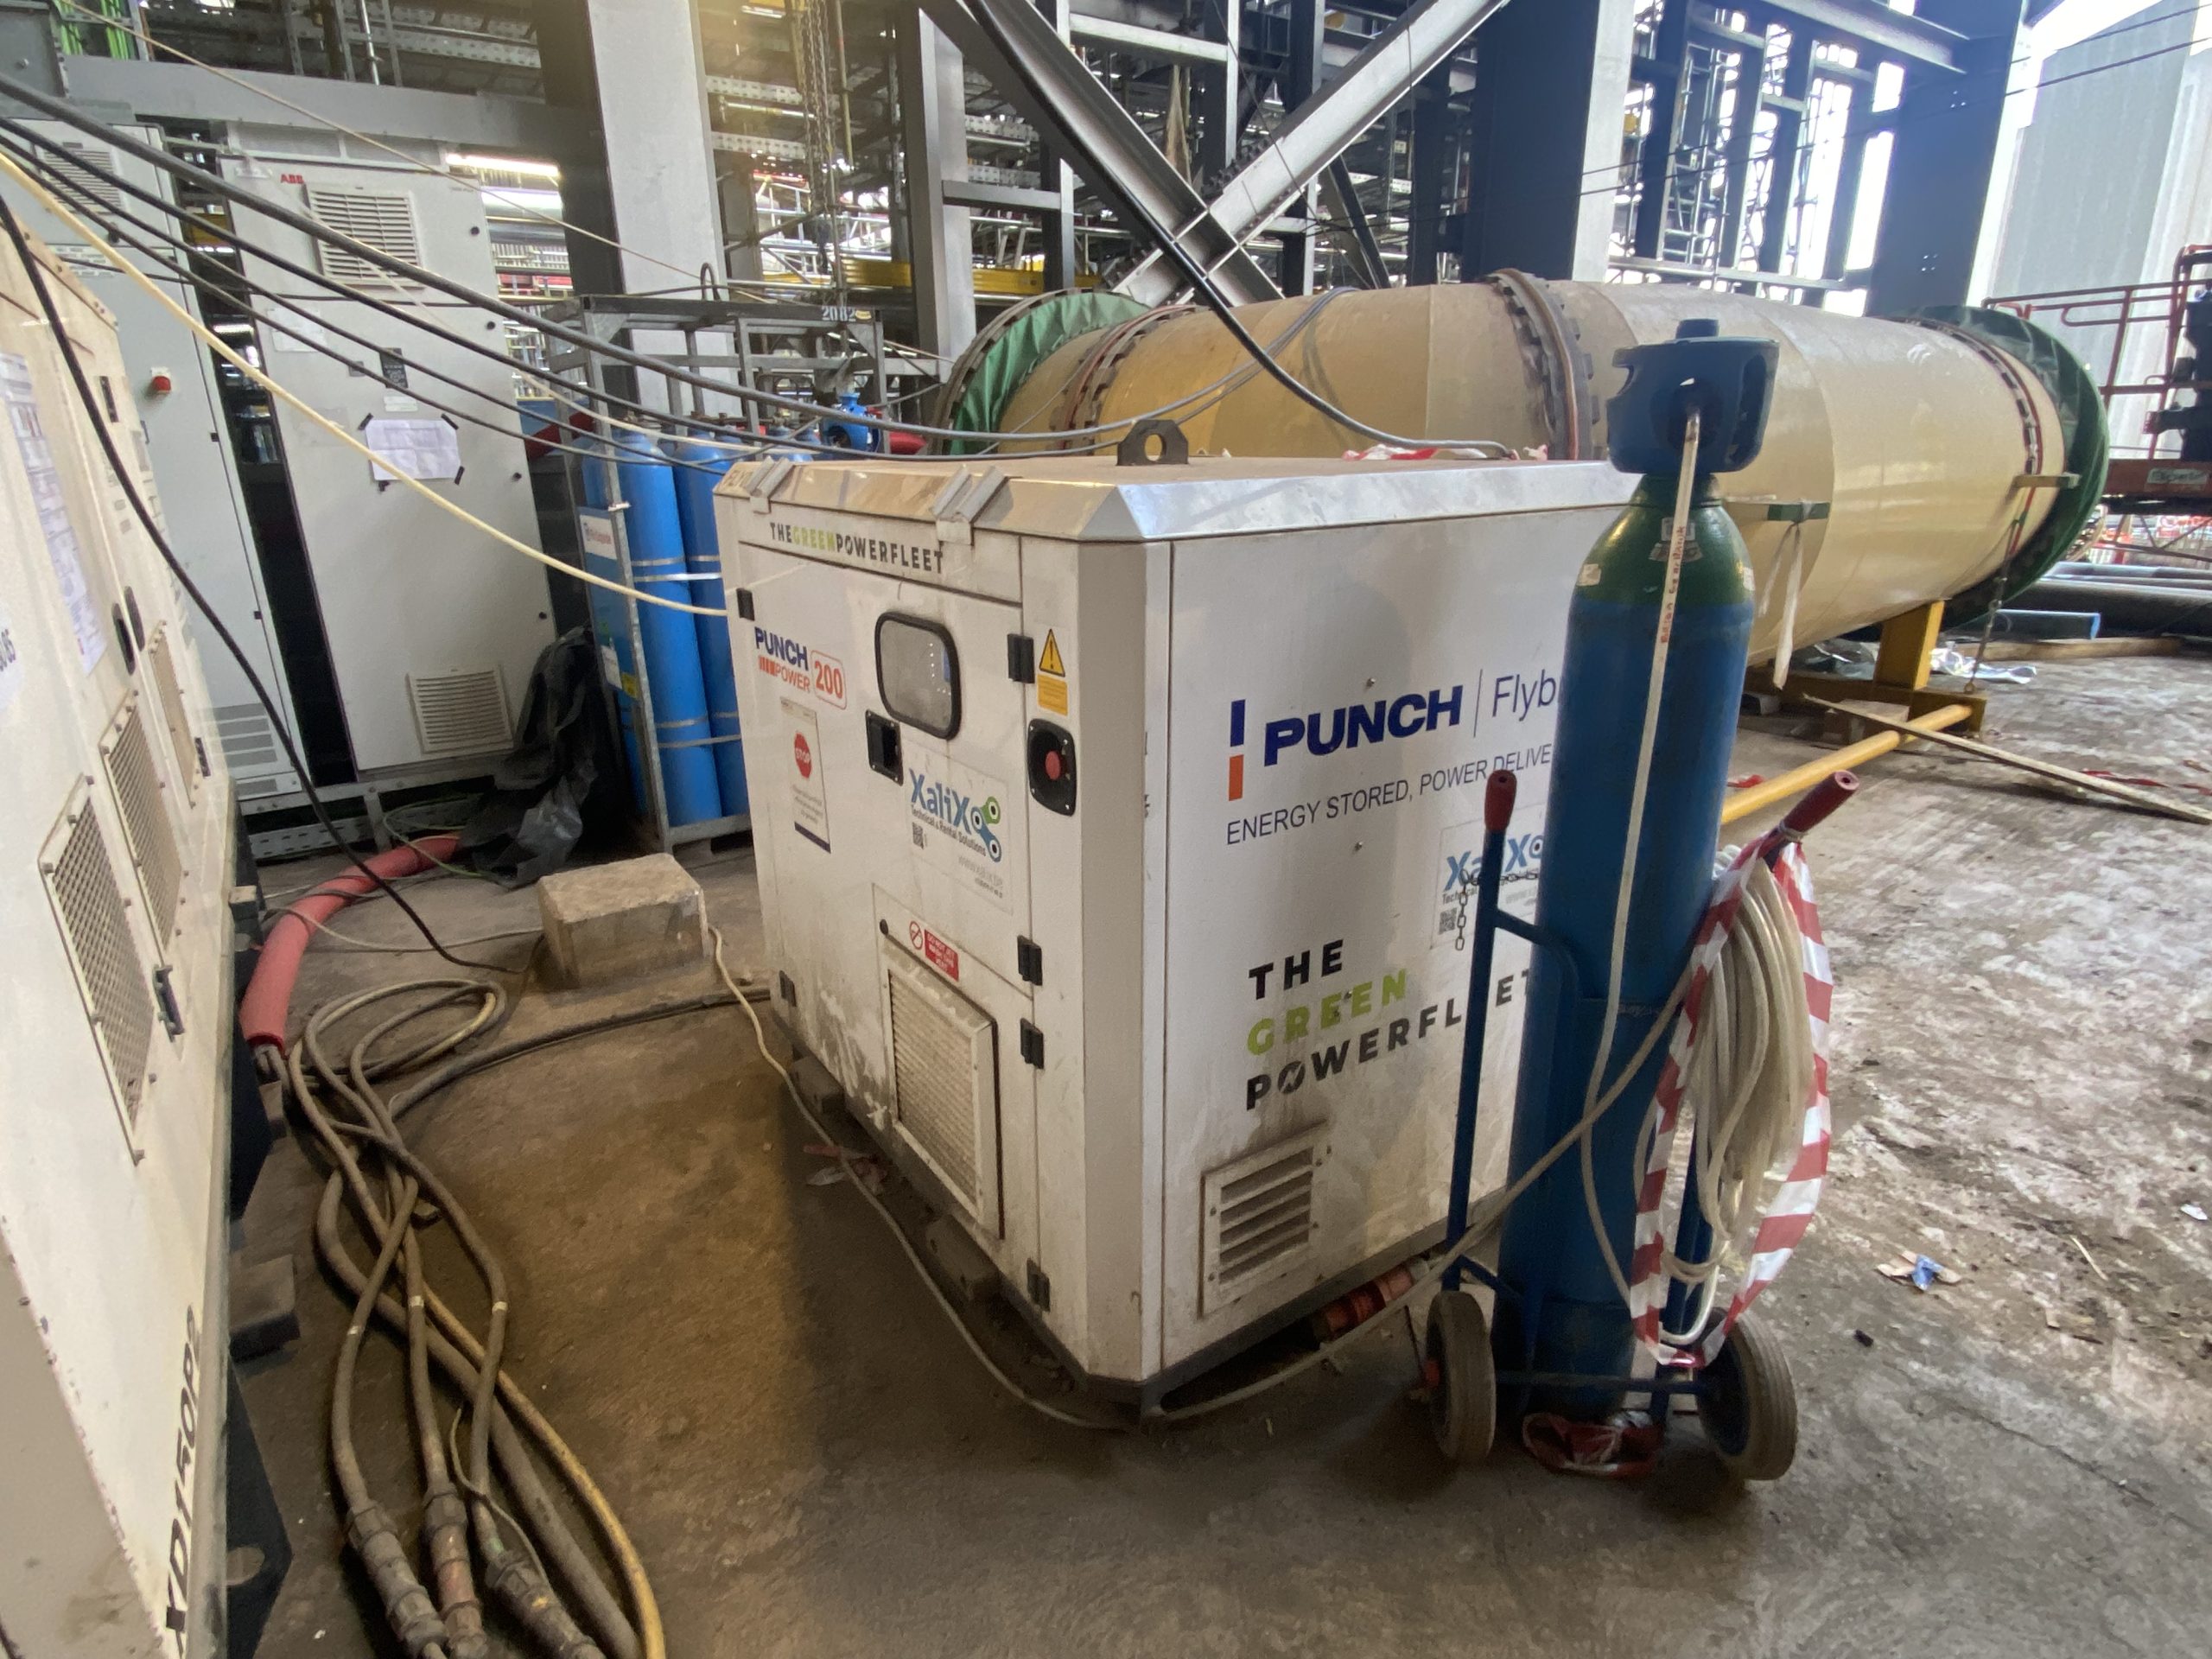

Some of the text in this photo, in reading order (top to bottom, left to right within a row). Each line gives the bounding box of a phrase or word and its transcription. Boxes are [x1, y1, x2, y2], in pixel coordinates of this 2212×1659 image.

[280, 174, 304, 184] ABB
[822, 306, 856, 321] 2082
[754, 626, 809, 671] PUNCH
[774, 662, 810, 694] POWER
[814, 659, 843, 700] 200
[1263, 668, 1557, 766] PUNCH Flyb
[795, 747, 811, 764] STOP
[1226, 743, 1553, 846] ENERGY STORED, POWER DELIVE
[911, 803, 935, 827] Technical
[957, 830, 987, 857] Solutions
[1444, 833, 1532, 892] XaX
[1248, 938, 1344, 1001] THE
[1247, 968, 1408, 1056] GREEN
[1246, 968, 1530, 1111] POWERFLE
